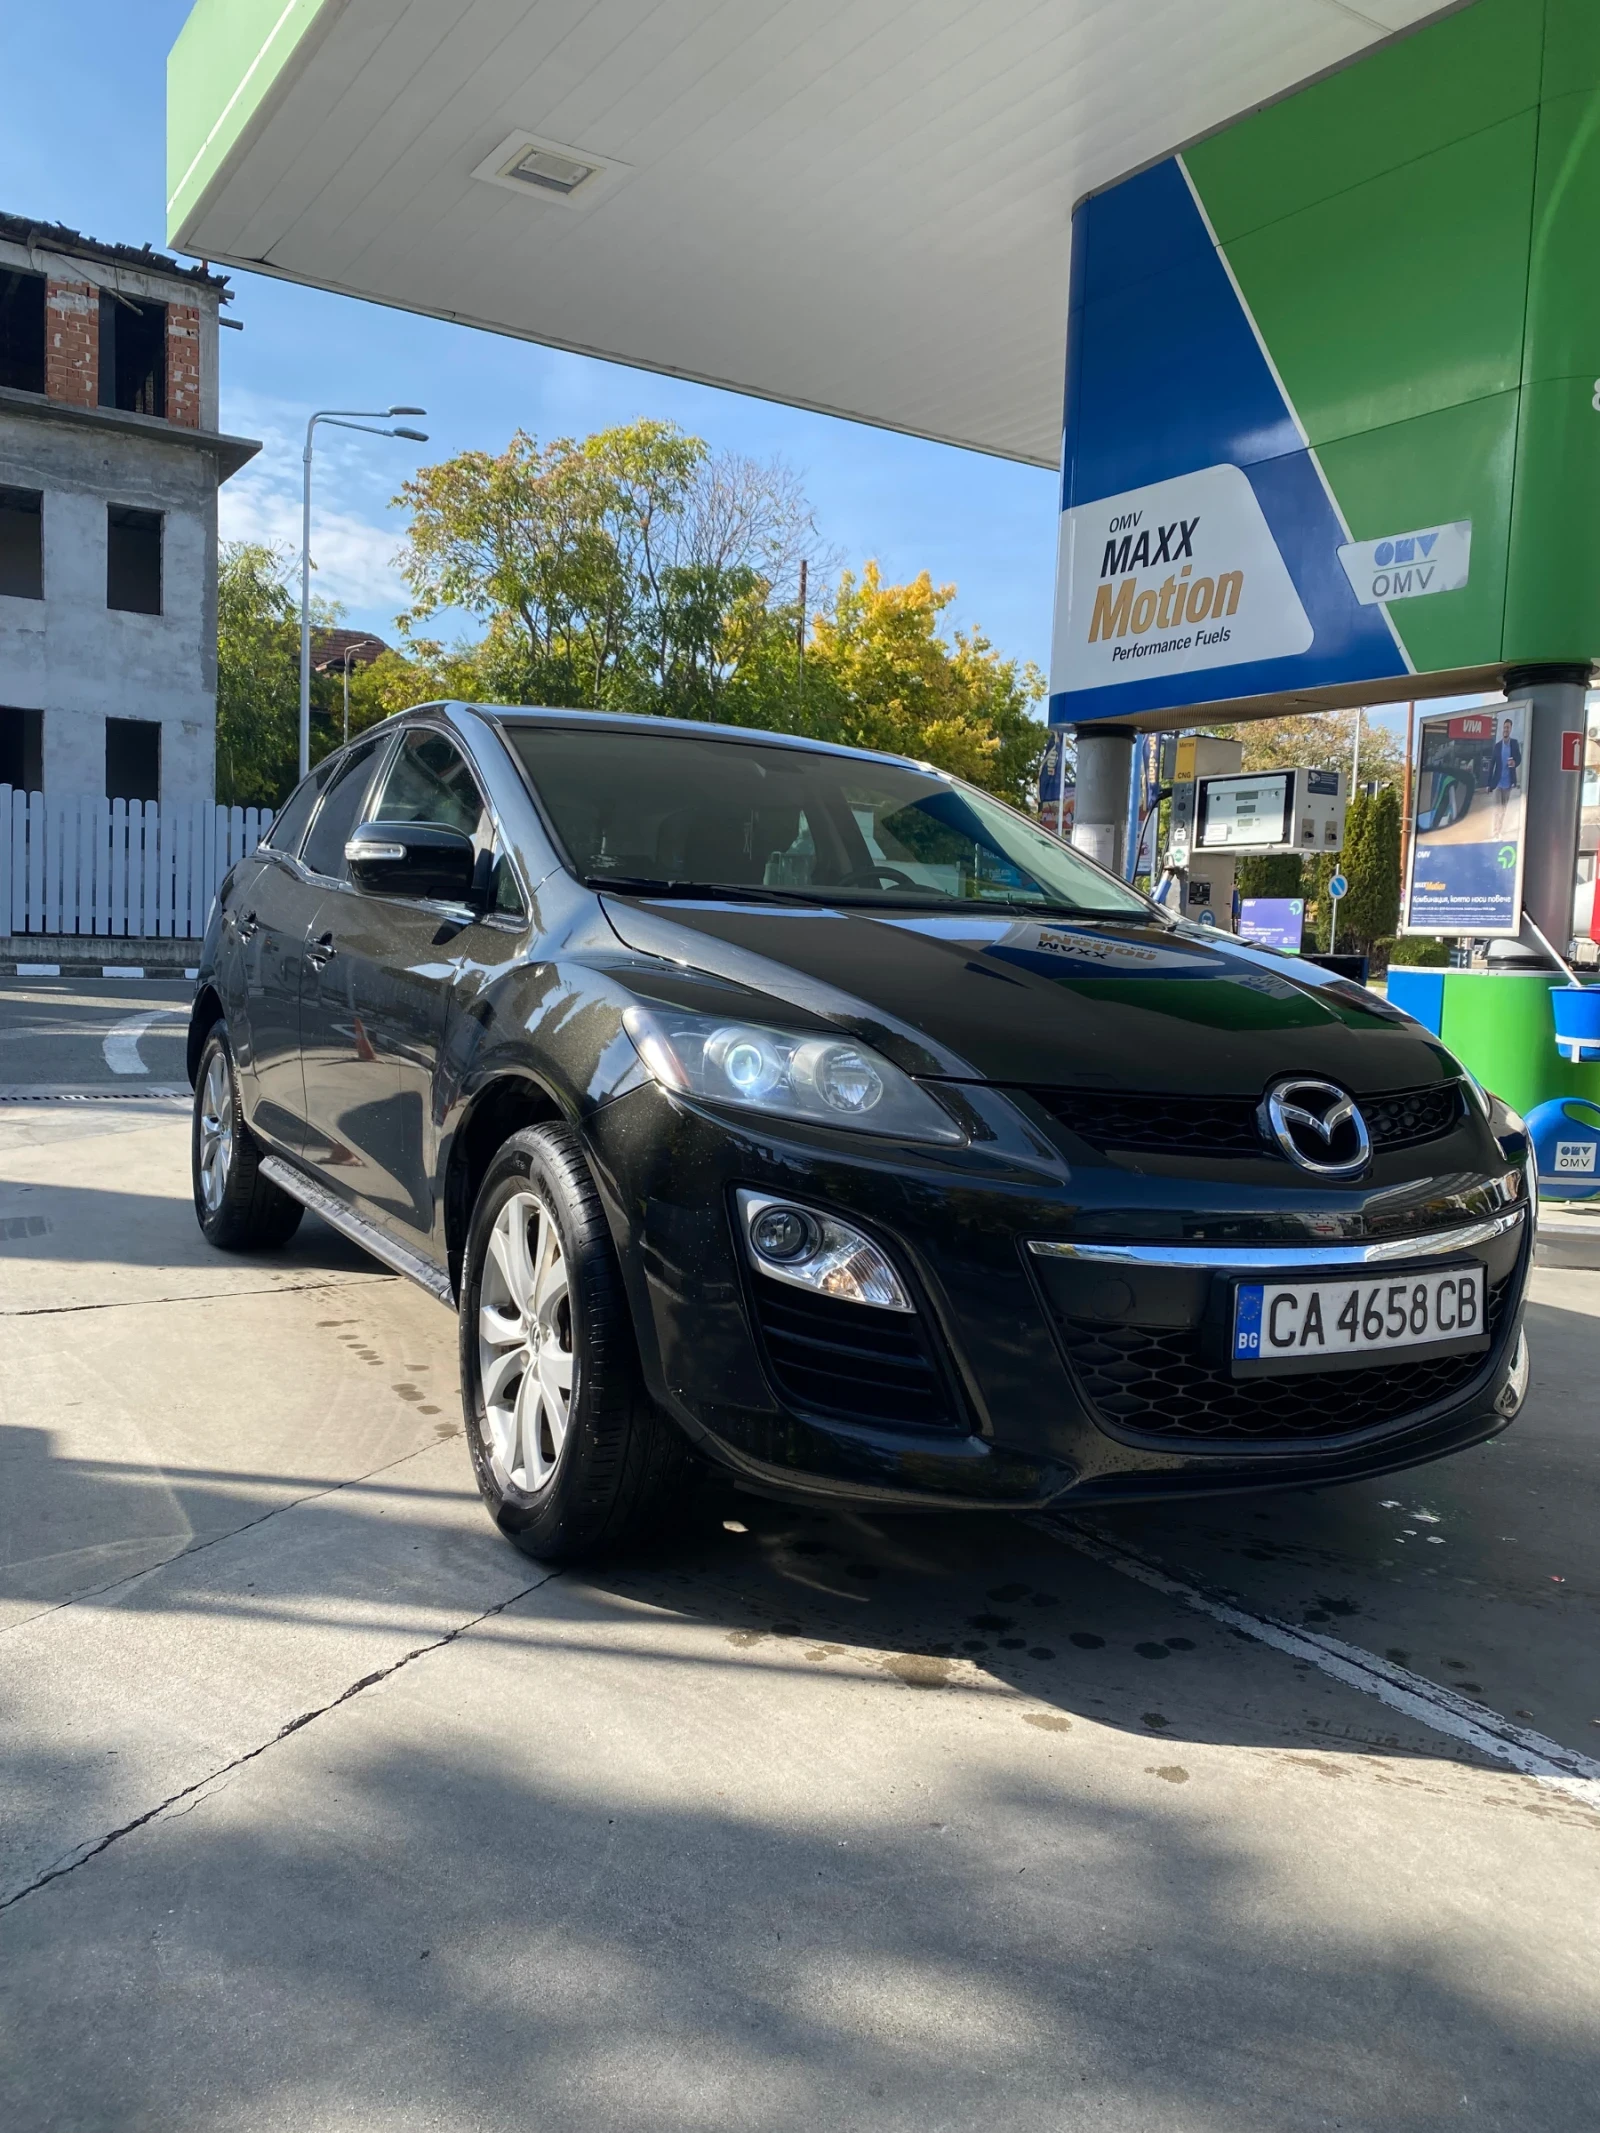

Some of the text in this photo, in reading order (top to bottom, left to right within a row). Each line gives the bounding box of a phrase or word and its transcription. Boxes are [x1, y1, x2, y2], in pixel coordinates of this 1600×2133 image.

[1109, 510, 1143, 533] OMV
[1100, 516, 1200, 578] MAXX
[1372, 566, 1435, 597] OMV
[1088, 564, 1244, 644] Motion
[1112, 626, 1231, 662] Performance Fuels
[1462, 719, 1482, 734] VIVA
[1177, 771, 1191, 779] CNG
[1412, 895, 1450, 904] Комбинация,
[1487, 894, 1512, 903] повече
[1560, 1158, 1591, 1167] OMV
[1238, 1276, 1478, 1349] BG CA 4658 CB
